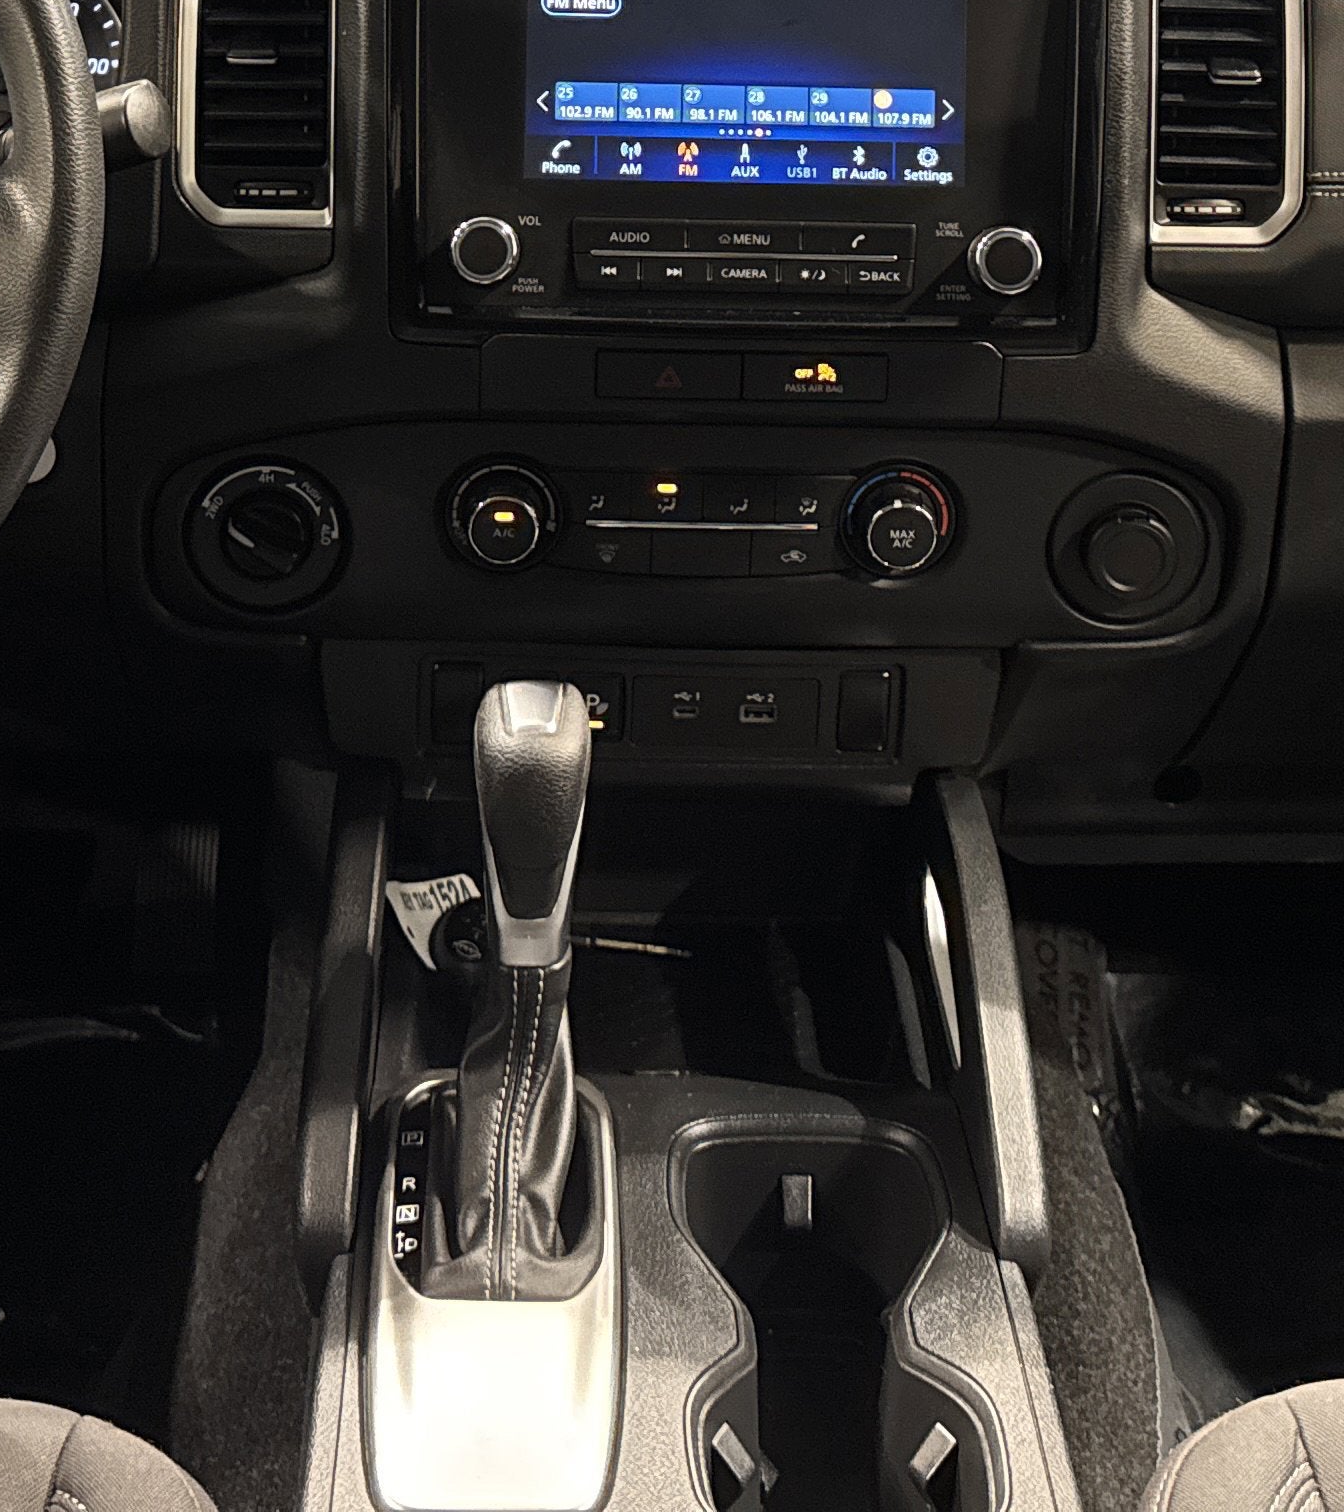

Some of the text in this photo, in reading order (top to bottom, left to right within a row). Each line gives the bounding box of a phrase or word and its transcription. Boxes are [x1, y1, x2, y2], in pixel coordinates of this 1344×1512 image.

[558, 87, 574, 99] 25
[621, 88, 638, 100] 26
[684, 89, 701, 101] 27
[748, 90, 765, 103] 28
[811, 91, 828, 104] 29
[559, 106, 614, 119] 102.9 FM
[626, 107, 674, 120] 90.1 FM
[689, 108, 738, 121] 98.1 FM
[751, 109, 805, 123] 106.1 FM
[814, 111, 869, 124] 104.1 FM
[877, 112, 932, 126] 107.9 FM
[541, 162, 580, 175] Phone
[619, 163, 642, 176] AM
[678, 164, 698, 176] FM
[731, 164, 760, 177] AUX
[787, 166, 818, 179] USB1
[832, 167, 887, 181] BT Audio
[904, 169, 953, 185] Settings
[518, 215, 542, 226] VOL
[609, 232, 651, 243] AUDIO
[733, 234, 771, 246] MENU
[720, 268, 768, 279] CAMERA
[871, 271, 902, 282] BACK
[512, 285, 545, 293] POWER
[794, 368, 814, 379] OFF
[784, 383, 807, 393] PASS
[808, 384, 824, 393] AIR
[258, 473, 275, 483] 4H
[204, 495, 225, 521] 2WD
[491, 528, 515, 538] A/C
[889, 529, 916, 539] MAX
[892, 539, 913, 549] A/C
[585, 693, 600, 710] P
[401, 1176, 417, 1193] R
